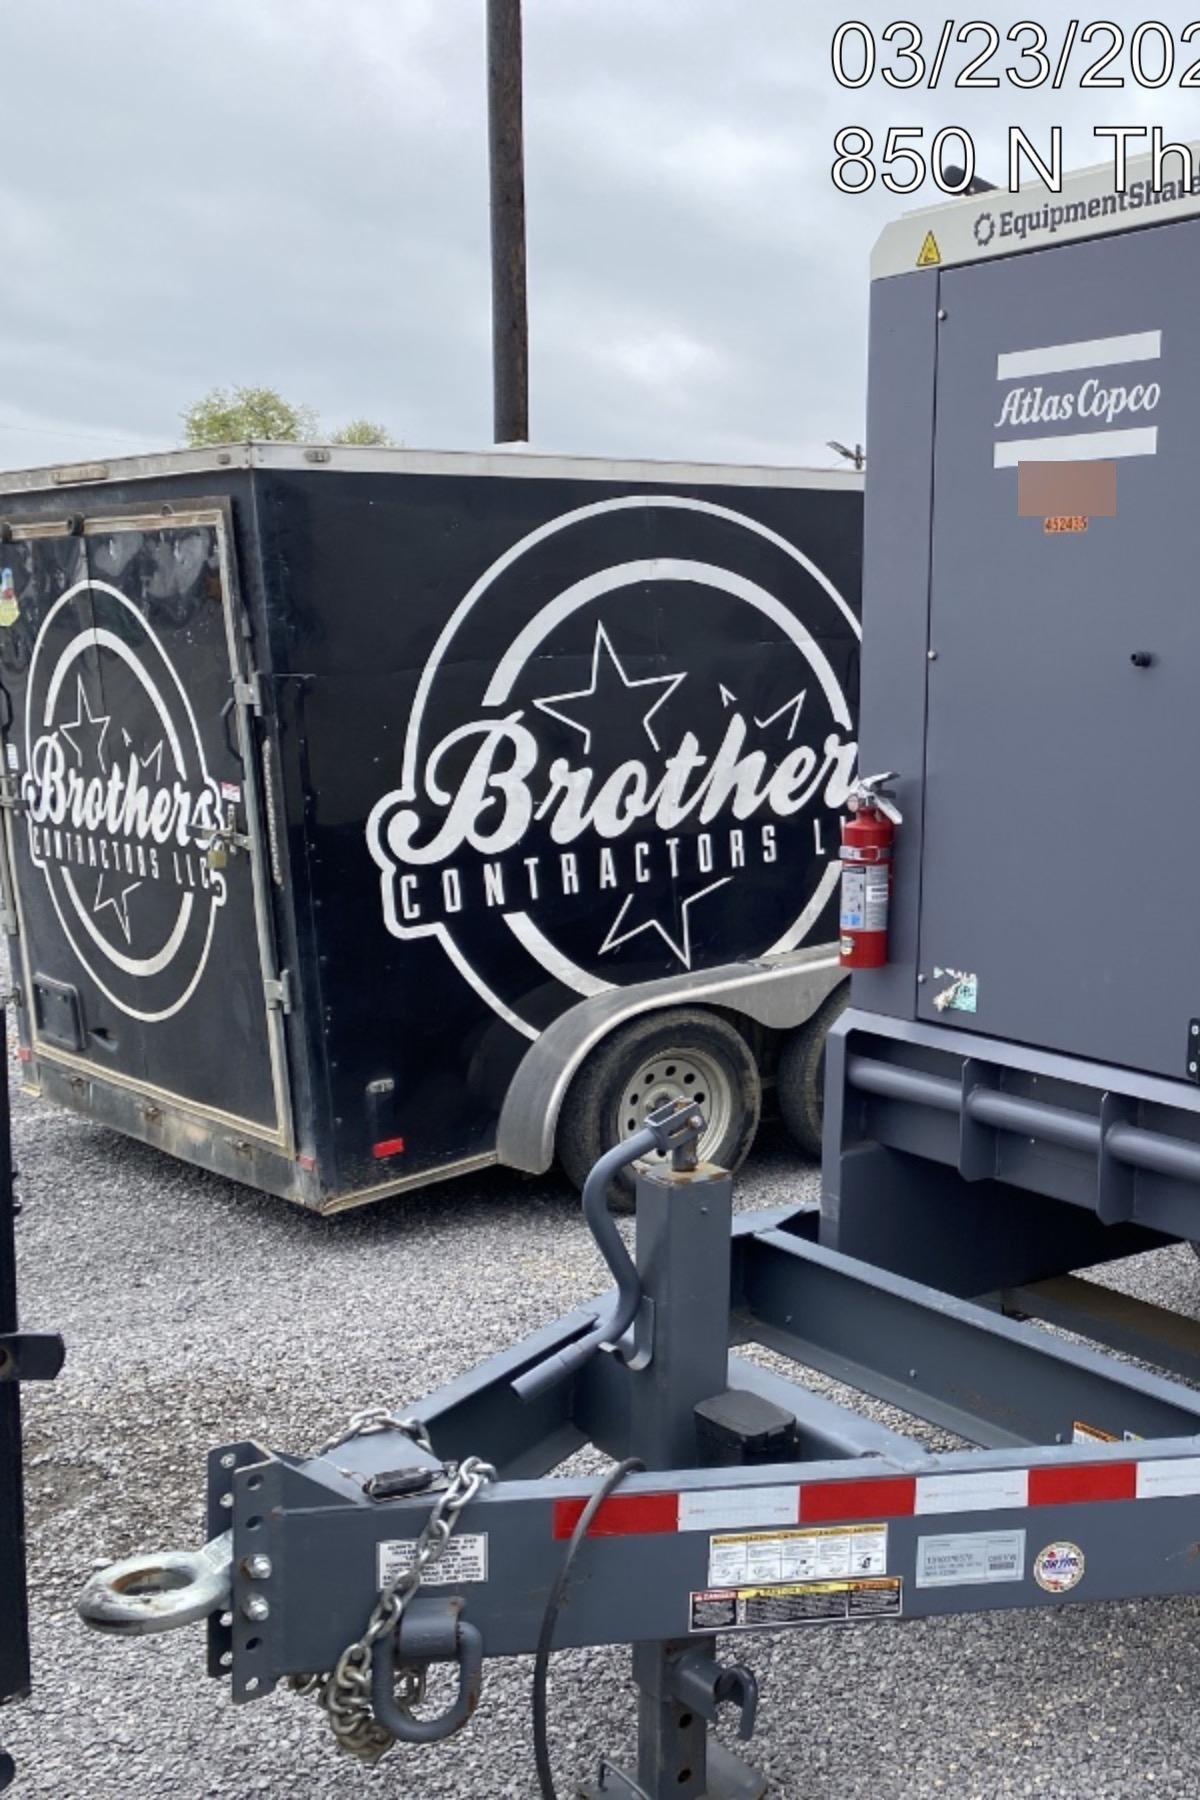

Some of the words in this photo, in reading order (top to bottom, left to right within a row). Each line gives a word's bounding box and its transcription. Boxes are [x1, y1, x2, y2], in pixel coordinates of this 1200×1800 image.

[994, 385, 1075, 428] Atlas
[1077, 378, 1161, 424] Copco
[28, 731, 214, 849] Brothers
[388, 710, 859, 865] Brother
[33, 826, 160, 879] CONTRACTORS
[173, 852, 210, 889] LLC
[400, 824, 778, 920] CONTRACTORS
